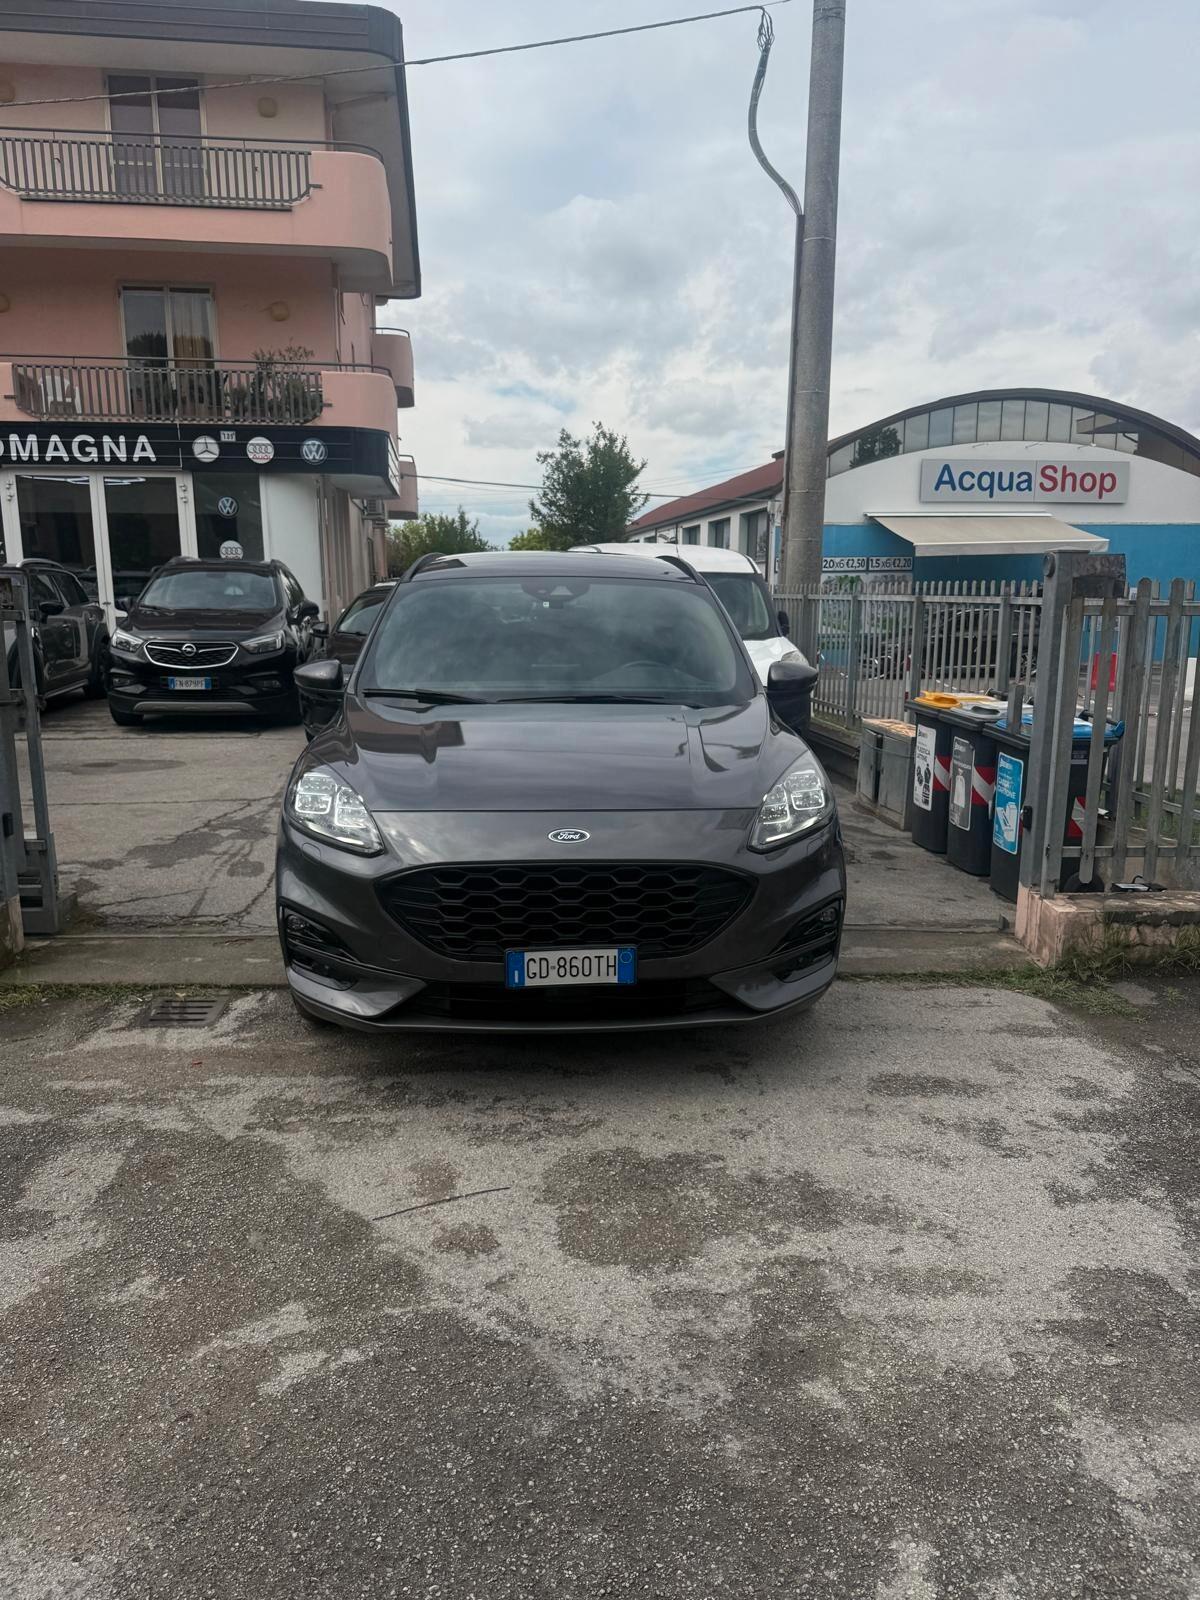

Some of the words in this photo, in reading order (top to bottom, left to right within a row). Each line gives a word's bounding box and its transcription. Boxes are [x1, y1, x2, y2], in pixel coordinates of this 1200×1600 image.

[0, 433, 157, 463] MAGNA
[934, 463, 1033, 498] Acqua
[1039, 464, 1117, 500] Shop
[557, 831, 580, 840] Ford
[526, 957, 550, 980] GD
[556, 955, 617, 978] 860TH
